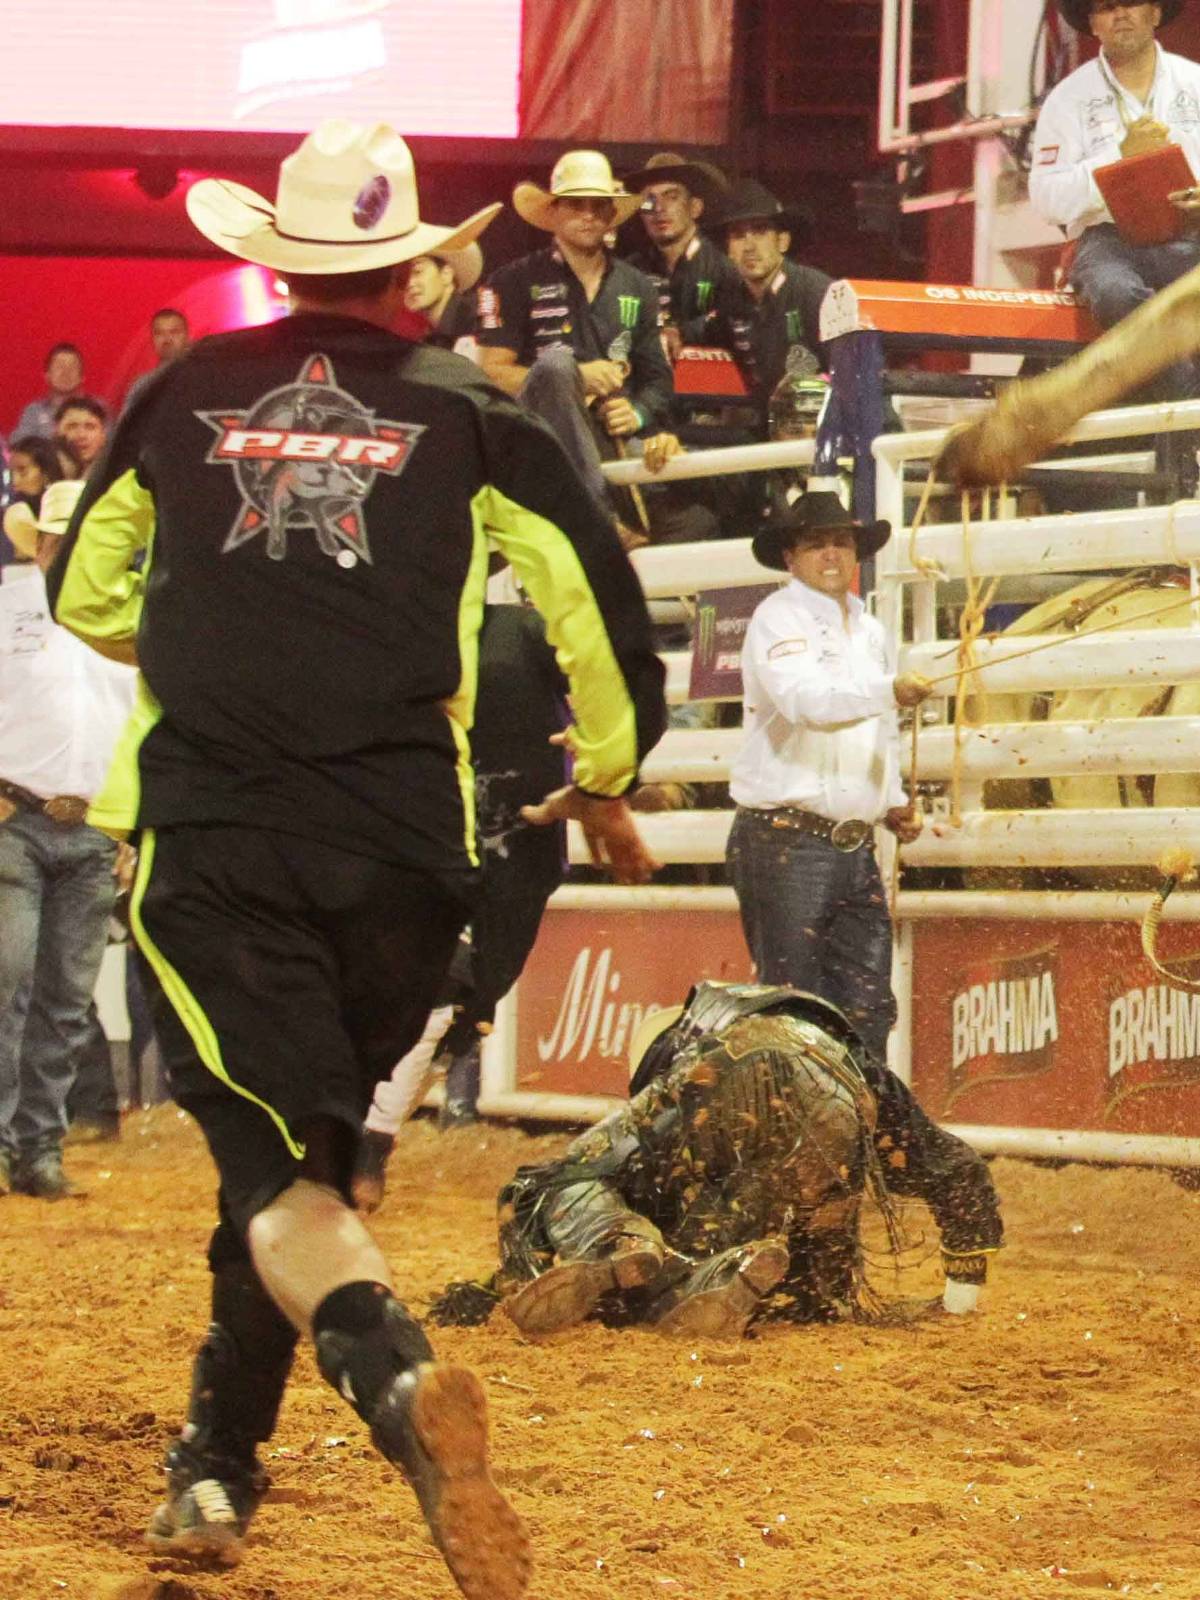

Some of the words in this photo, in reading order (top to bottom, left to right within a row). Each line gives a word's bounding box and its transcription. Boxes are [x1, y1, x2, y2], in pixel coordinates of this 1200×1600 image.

[925, 287, 960, 299] OS
[221, 430, 401, 464] PBR
[537, 947, 662, 1062] Min
[952, 971, 1059, 1070] BRAHMA
